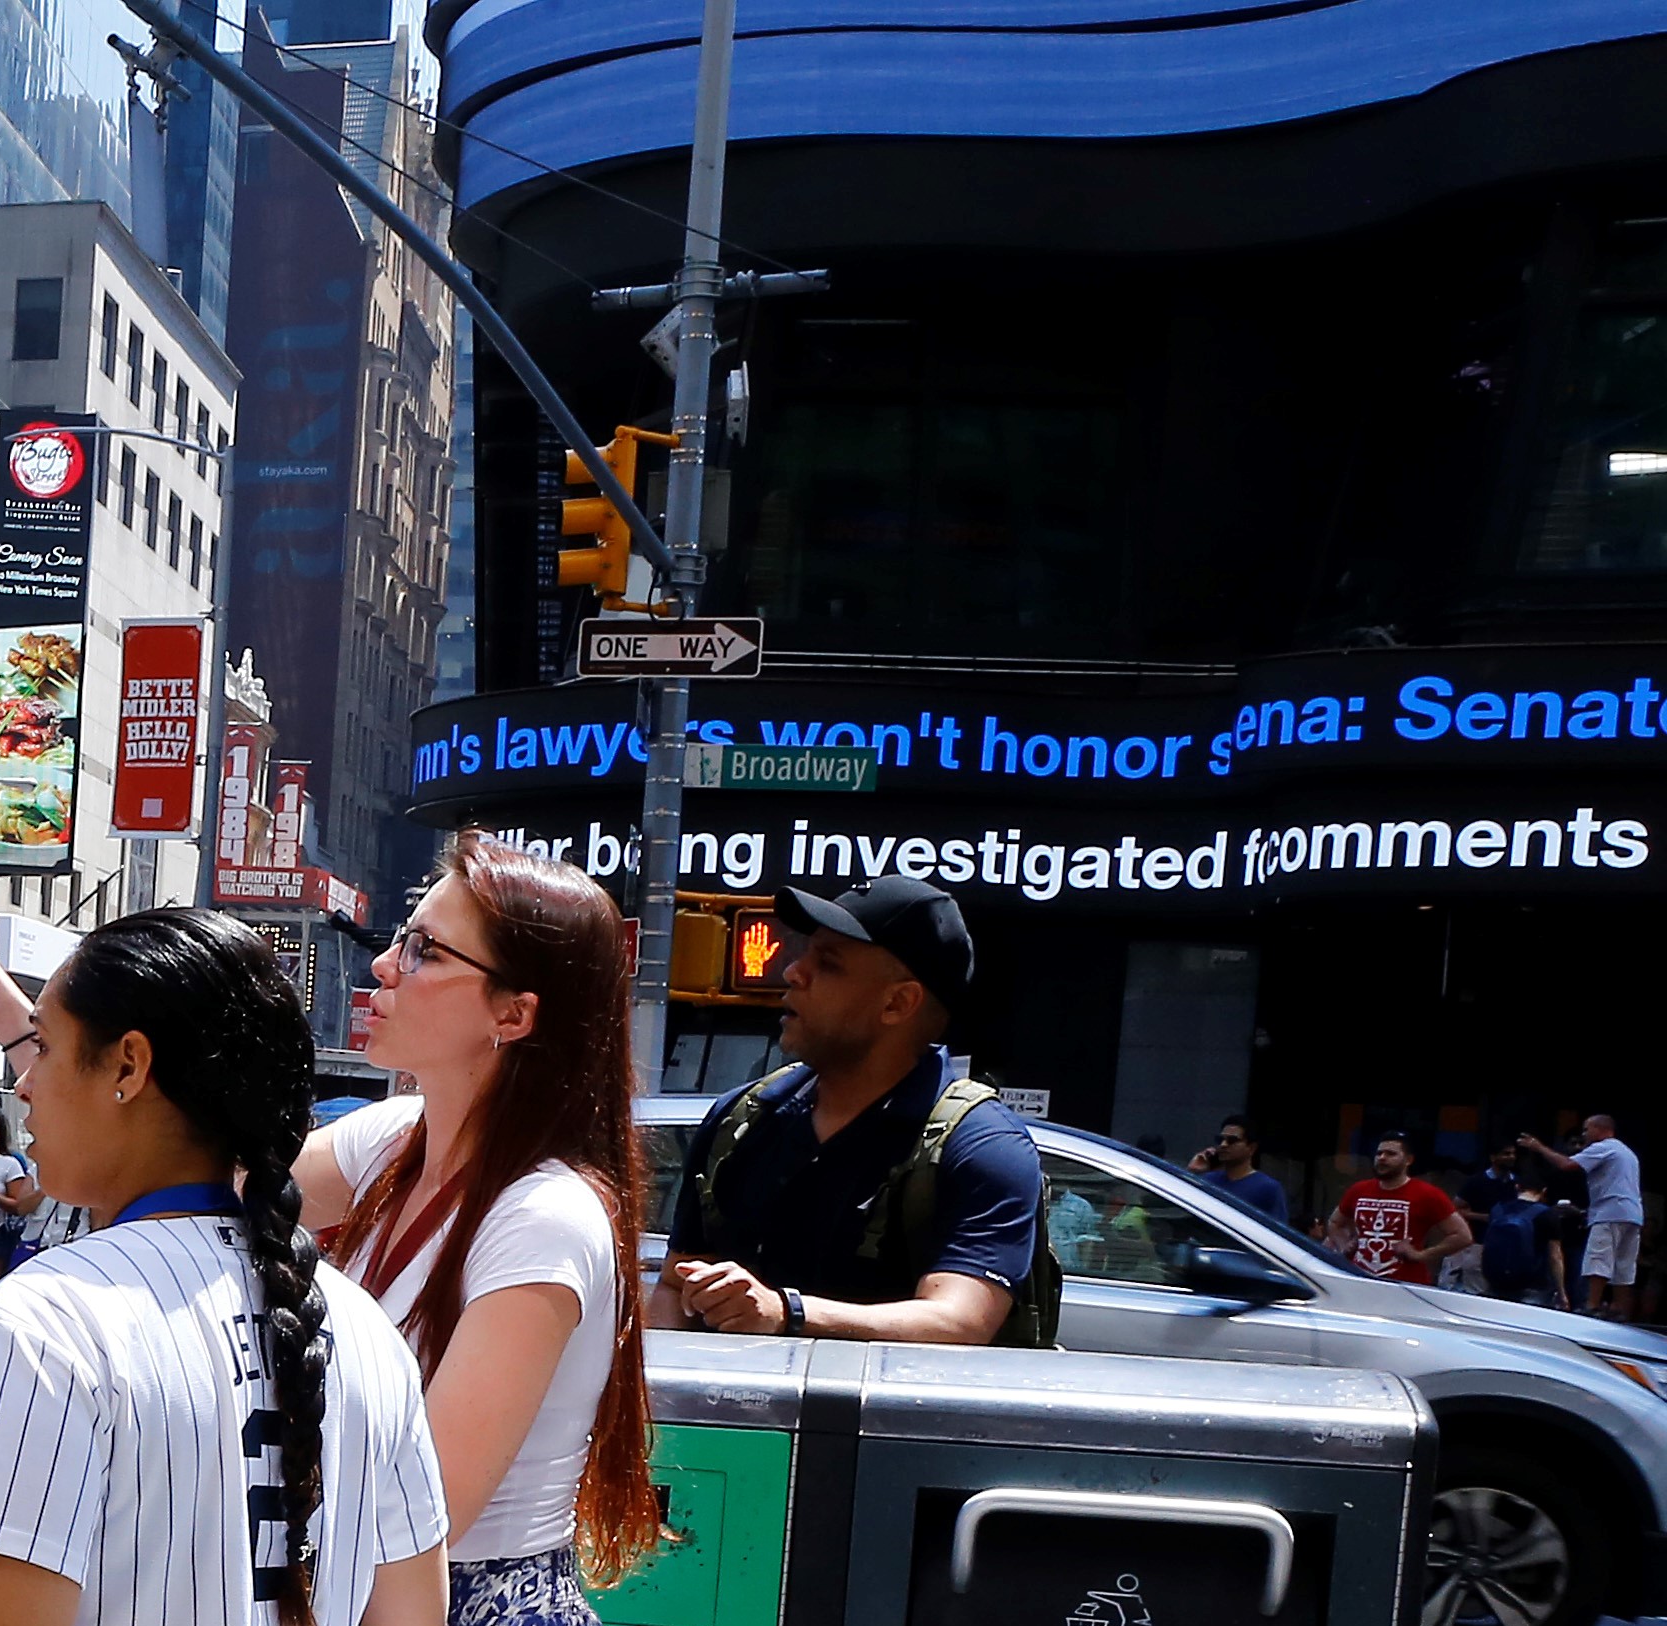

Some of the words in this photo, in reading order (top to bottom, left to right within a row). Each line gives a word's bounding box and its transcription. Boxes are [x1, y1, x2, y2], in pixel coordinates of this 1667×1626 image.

[45, 546, 84, 566] Soon
[596, 636, 648, 659] ONE
[678, 636, 736, 659] WAY
[127, 678, 194, 698] BETTE
[122, 698, 196, 718] MIDLER
[1236, 695, 1365, 751] ena:
[1394, 675, 1667, 741] Senat
[126, 720, 191, 742] HELLO,
[124, 740, 190, 762] DOLLY!
[412, 724, 482, 795] nn's
[980, 716, 1192, 780] honor
[731, 749, 868, 790] Broadway
[219, 745, 250, 867] 1984
[273, 783, 299, 868] 198
[1266, 807, 1649, 869] comments
[790, 819, 1228, 900] investigated
[218, 870, 237, 882] BIG
[239, 871, 290, 885] BROTHER
[292, 872, 304, 885] IS
[219, 883, 276, 897] WATCHING
[278, 884, 301, 898] YOU
[222, 1312, 332, 1387] JET
